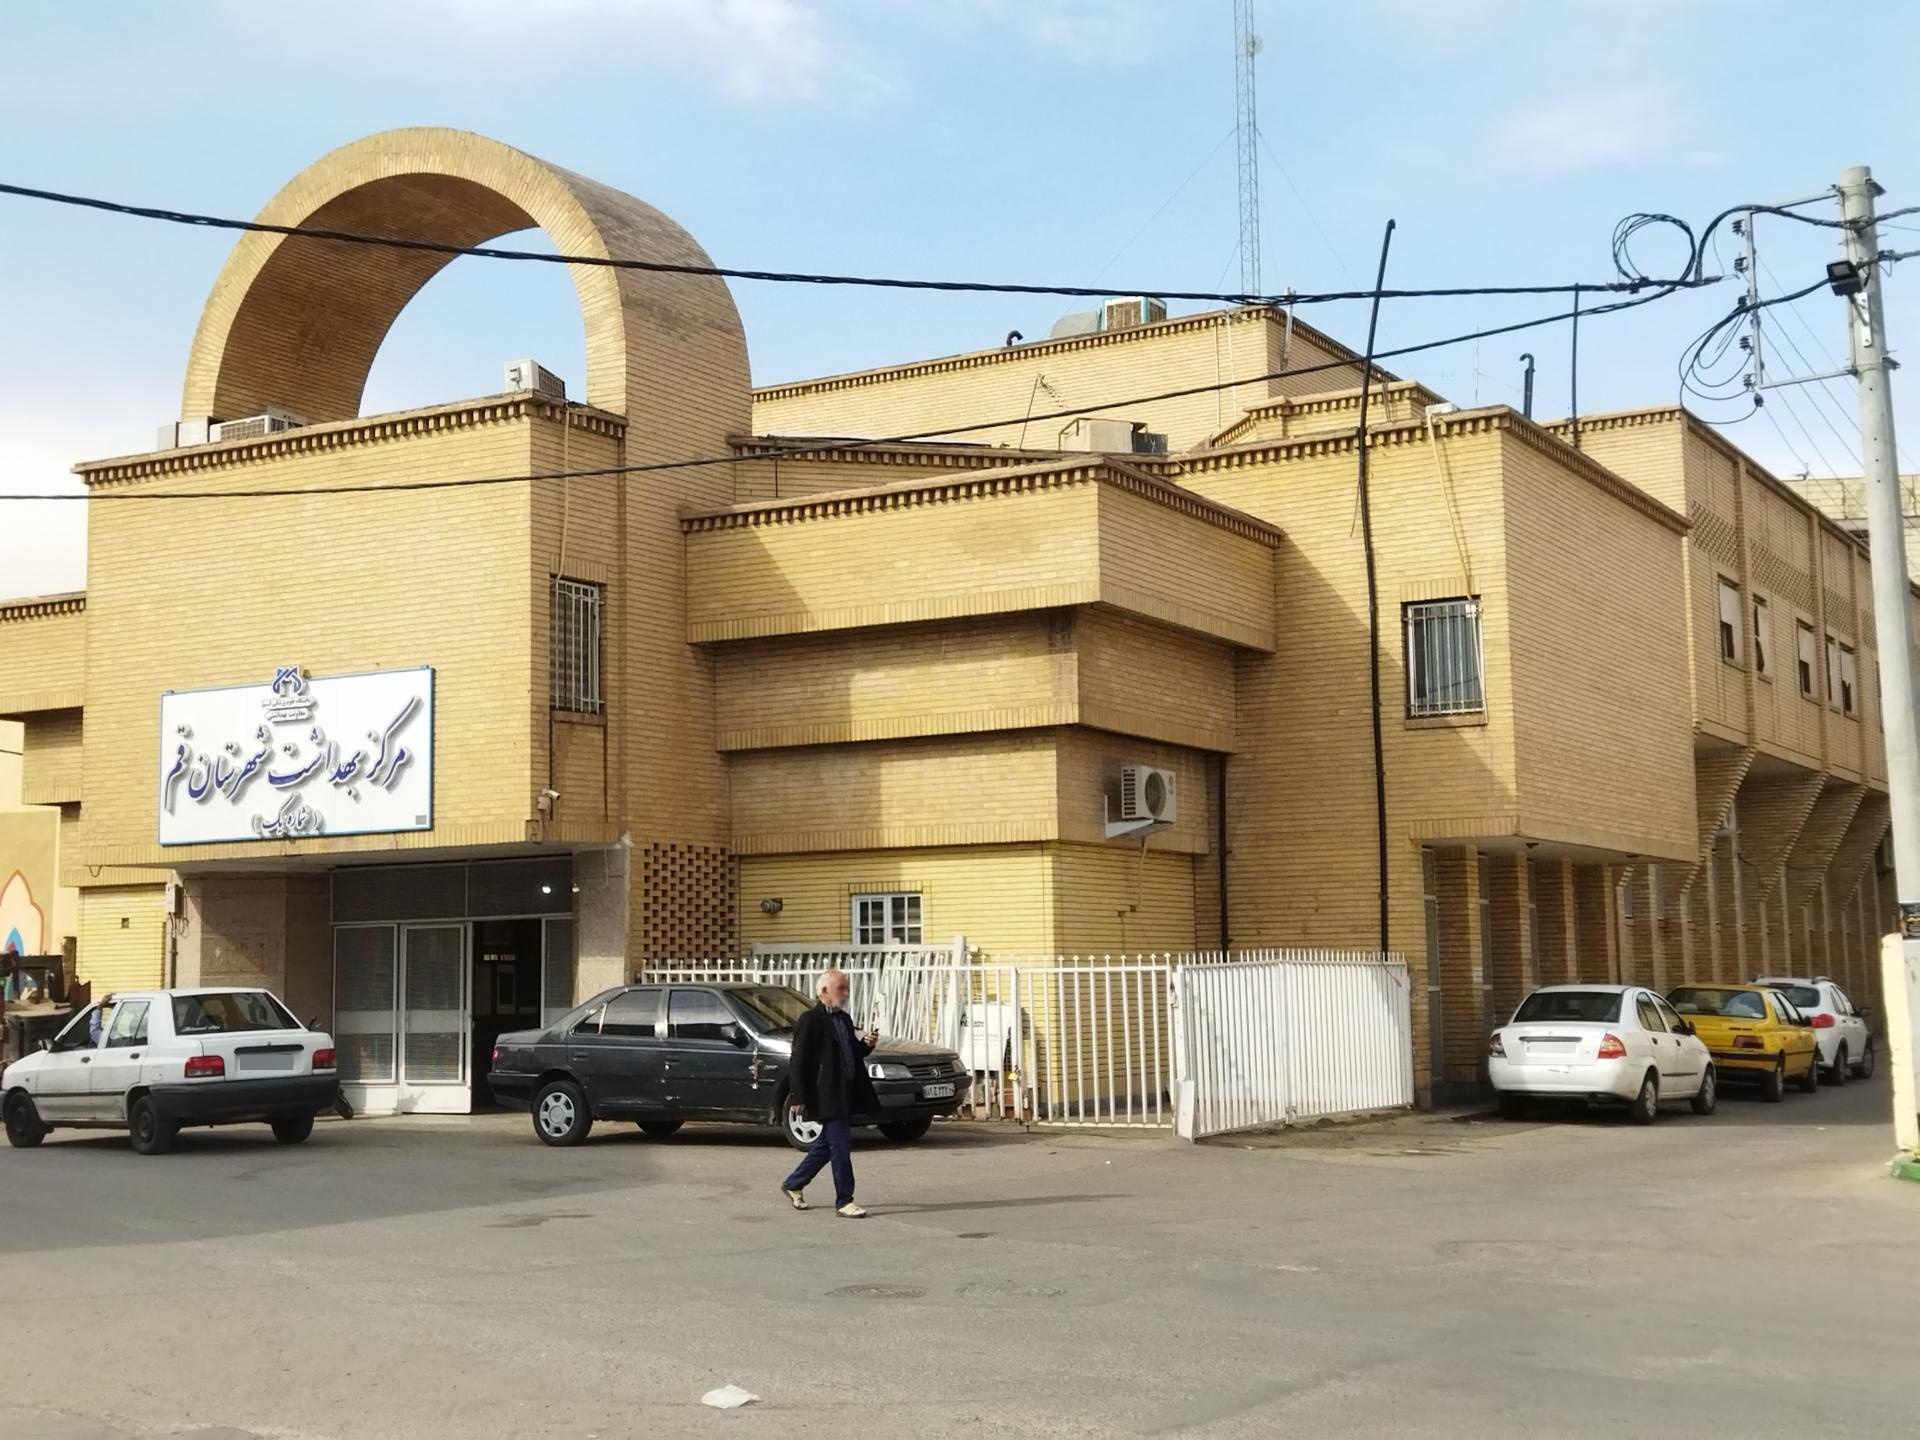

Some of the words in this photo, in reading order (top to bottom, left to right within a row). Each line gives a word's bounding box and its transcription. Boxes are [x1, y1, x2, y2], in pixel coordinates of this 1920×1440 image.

[164, 725, 187, 811] قم
[188, 725, 268, 799] شهرستان
[268, 727, 362, 797] بهداشت
[366, 696, 416, 787] مرکز
